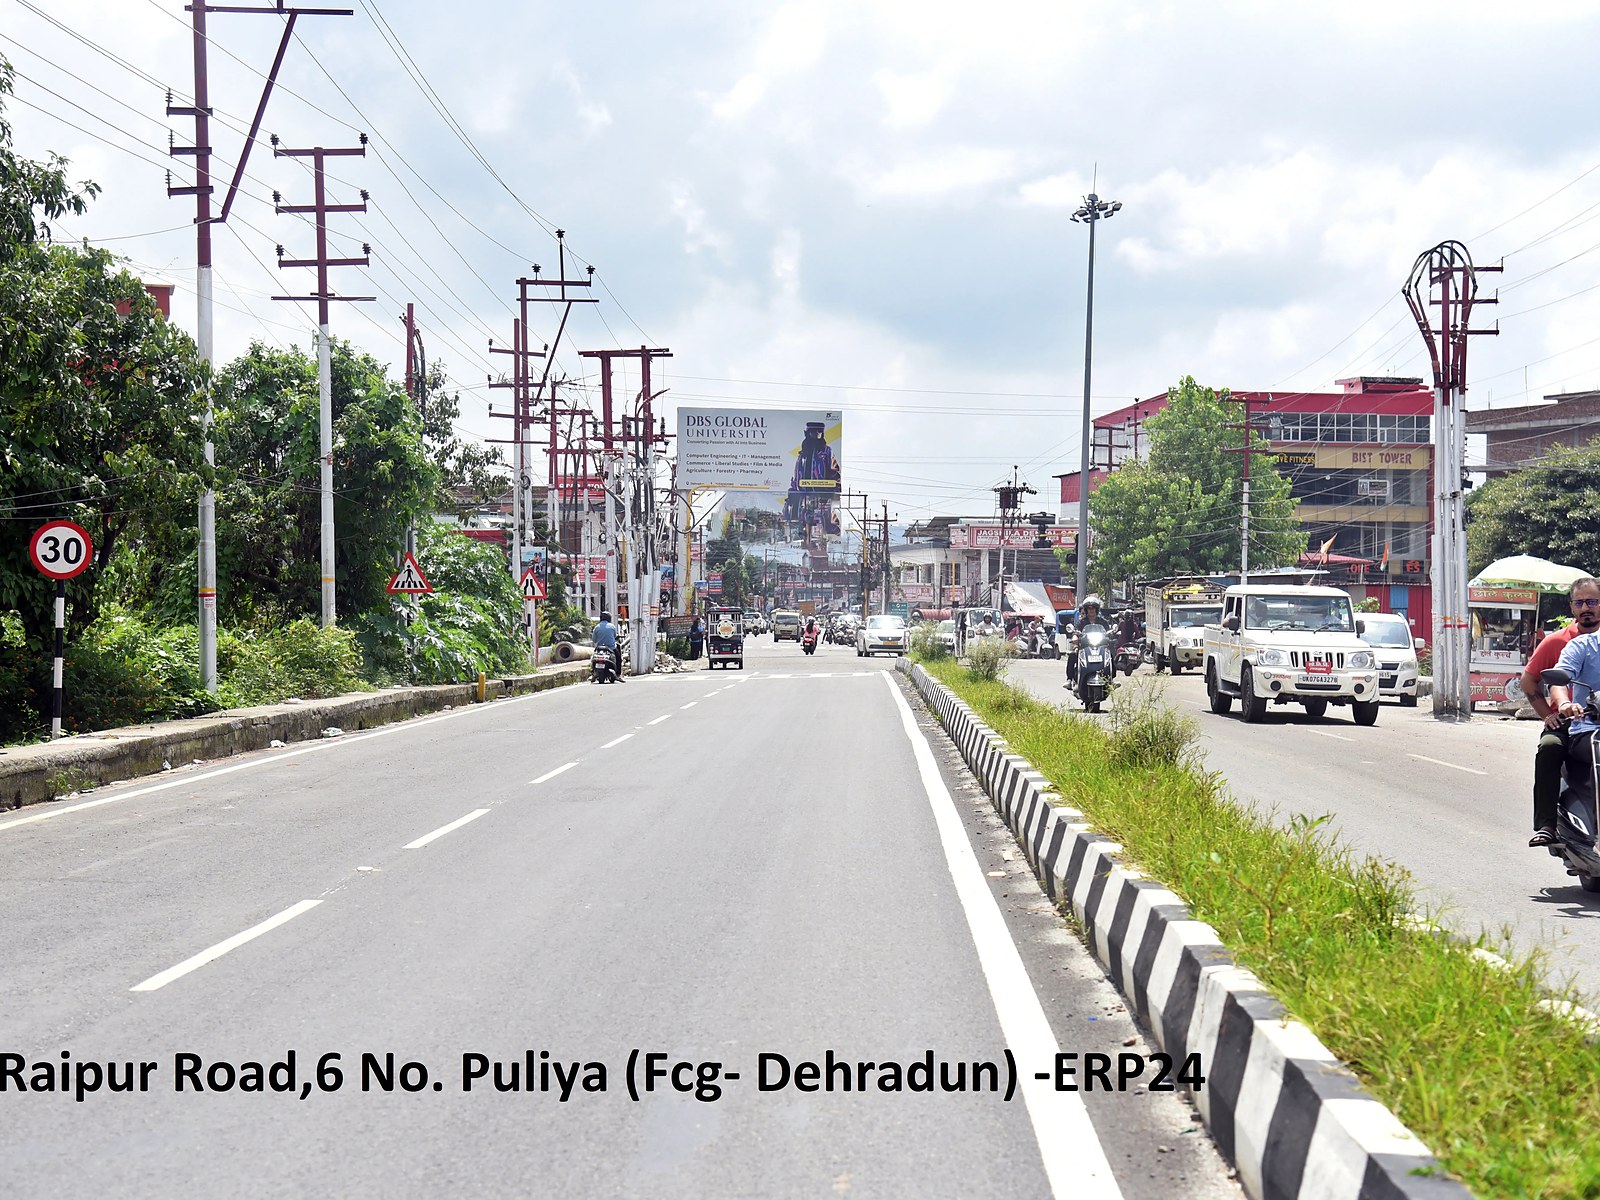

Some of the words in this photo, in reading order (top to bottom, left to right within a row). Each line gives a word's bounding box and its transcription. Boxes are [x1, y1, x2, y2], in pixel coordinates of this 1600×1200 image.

[686, 415, 711, 427] DBS
[715, 416, 767, 428] GLOBAL
[686, 429, 767, 438] UNIVERSITY
[1290, 456, 1315, 465] FITNESS
[1352, 452, 1373, 463] BIST
[1379, 453, 1411, 464] TOWER
[41, 536, 82, 564] 30
